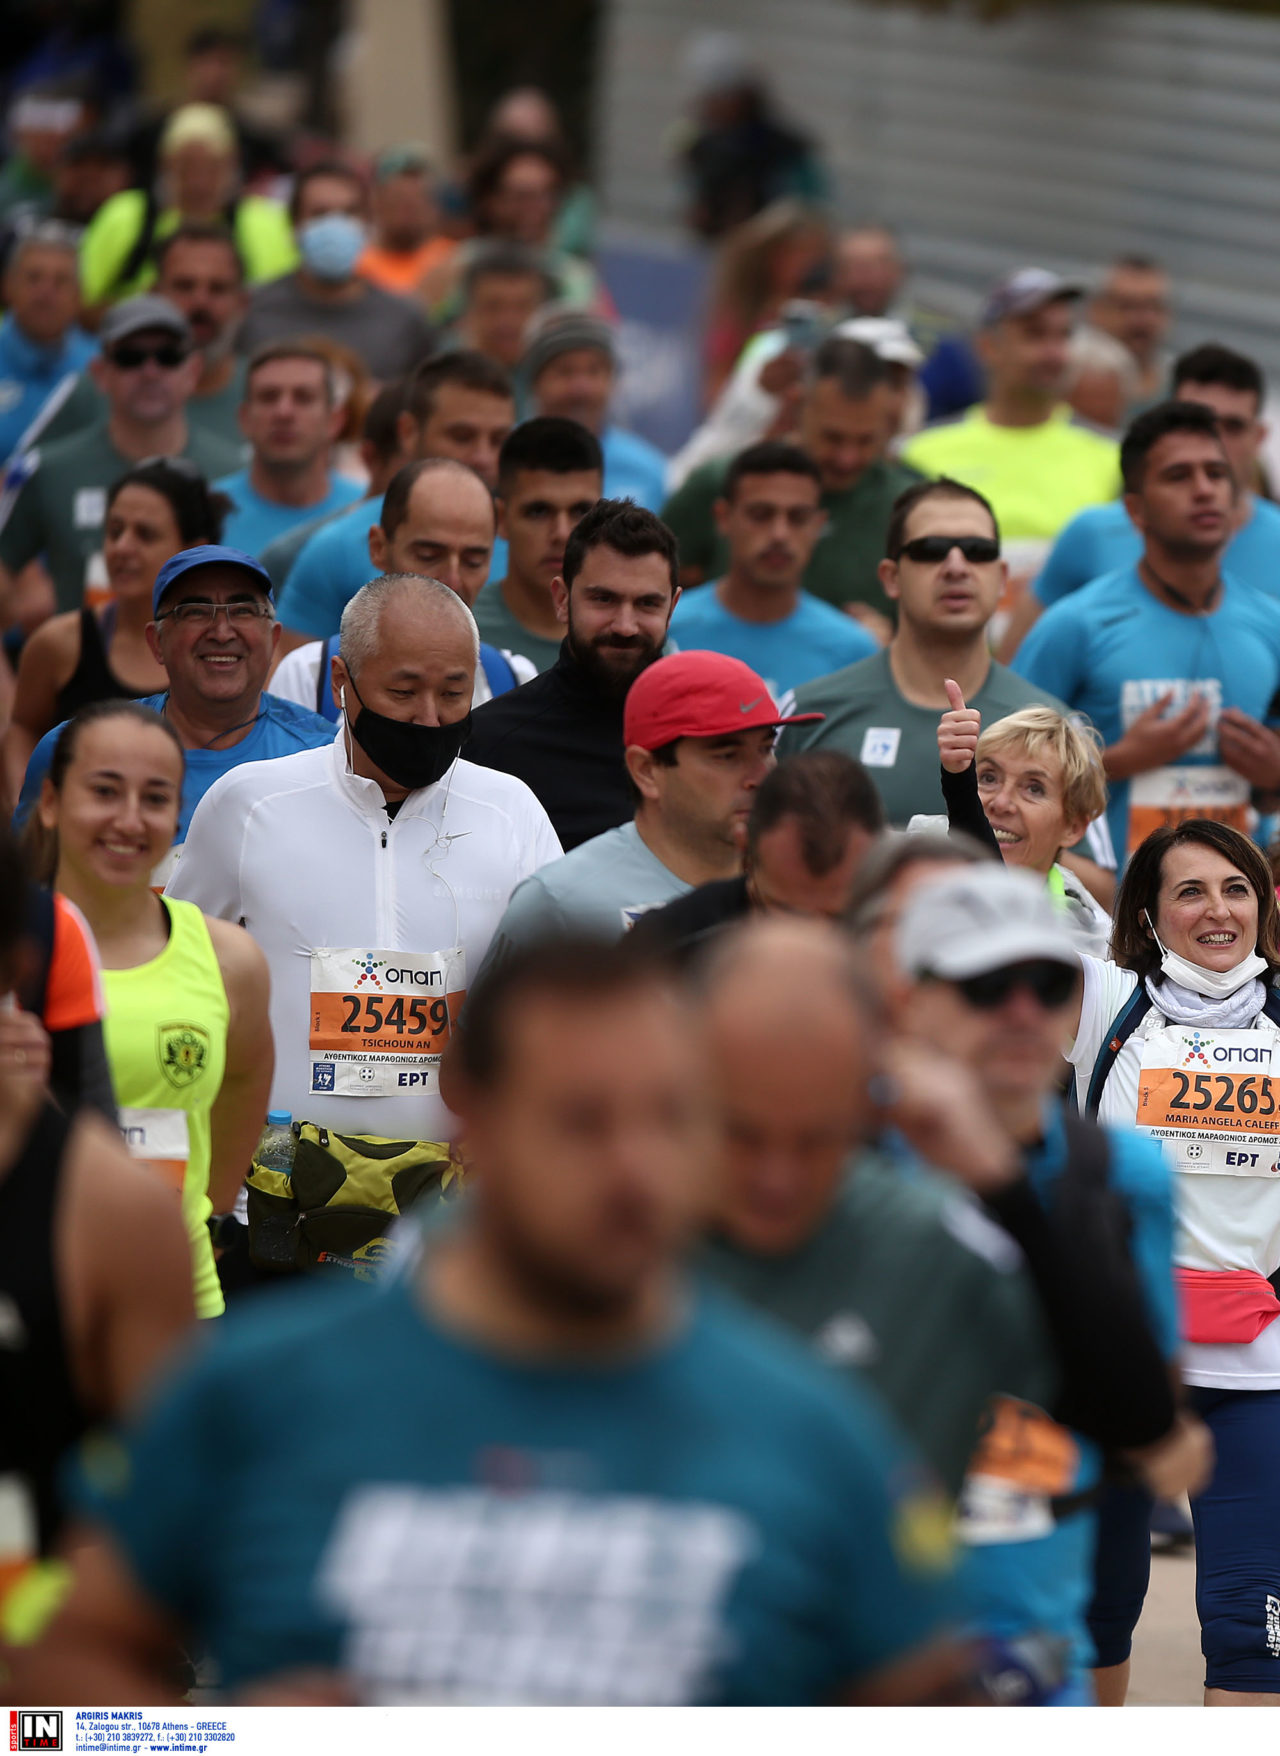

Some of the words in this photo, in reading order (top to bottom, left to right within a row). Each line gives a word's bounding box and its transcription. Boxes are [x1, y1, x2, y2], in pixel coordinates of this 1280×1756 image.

[341, 995, 448, 1036] 25459
[361, 1039, 414, 1048] TSICHOUN
[416, 1040, 431, 1049] AN
[324, 1053, 368, 1062] ΑΥΘΕΝΤΙΚΟΣ
[369, 1054, 417, 1063] ΜΑΡΑΘΩΝΙΟΣ
[1170, 1071, 1275, 1115] 25265
[1165, 1114, 1199, 1124] MARIA
[1202, 1117, 1242, 1128] ANGELA
[1150, 1129, 1196, 1139] ΑΥΘΕΝΤΙΚΟΣ
[1198, 1132, 1247, 1142] ΜΑΡΑΘΩΝΙΟΣ
[1248, 1135, 1279, 1144] ΔΡΟΜΟΣ
